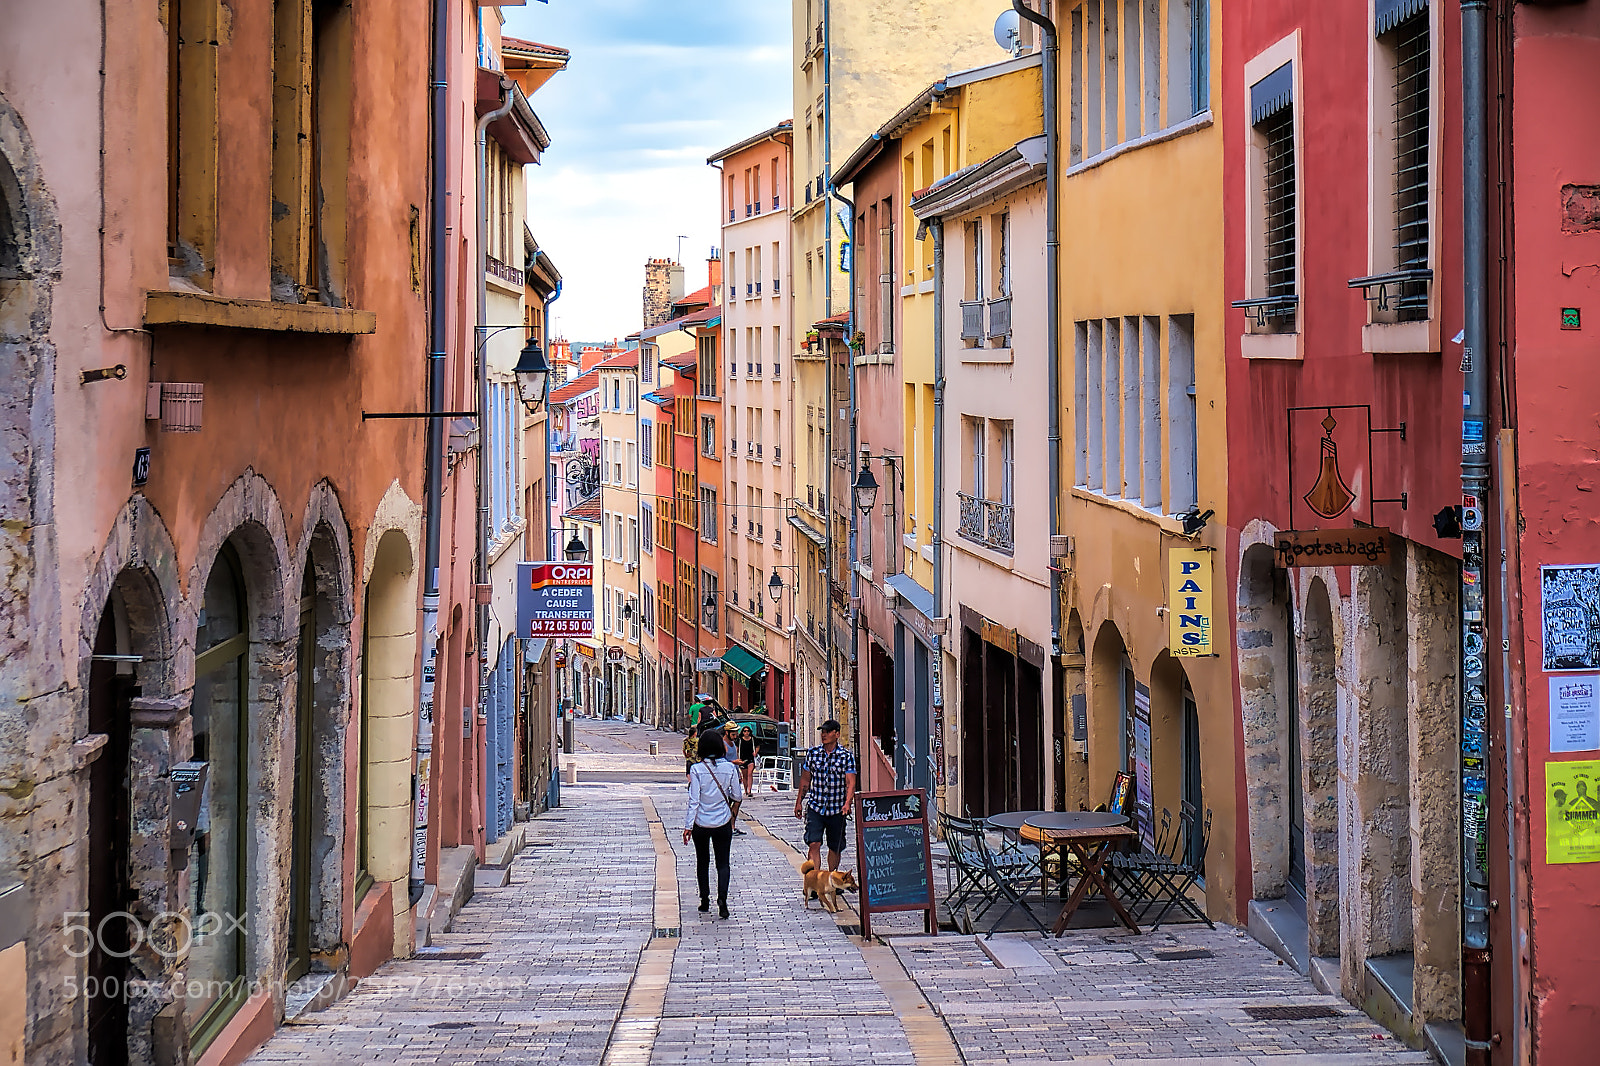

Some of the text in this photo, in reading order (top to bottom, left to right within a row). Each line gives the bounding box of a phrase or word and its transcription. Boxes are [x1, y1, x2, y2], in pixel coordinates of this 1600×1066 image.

[138, 454, 149, 479] 63
[552, 565, 591, 579] ORPI
[541, 588, 583, 597] A CEDER
[546, 599, 578, 608] CAUSE
[1178, 561, 1203, 646] PAINS
[535, 610, 592, 619] TRANSFERT
[532, 620, 592, 631] 04 72 05 50 00
[1565, 810, 1598, 822] SUMMER
